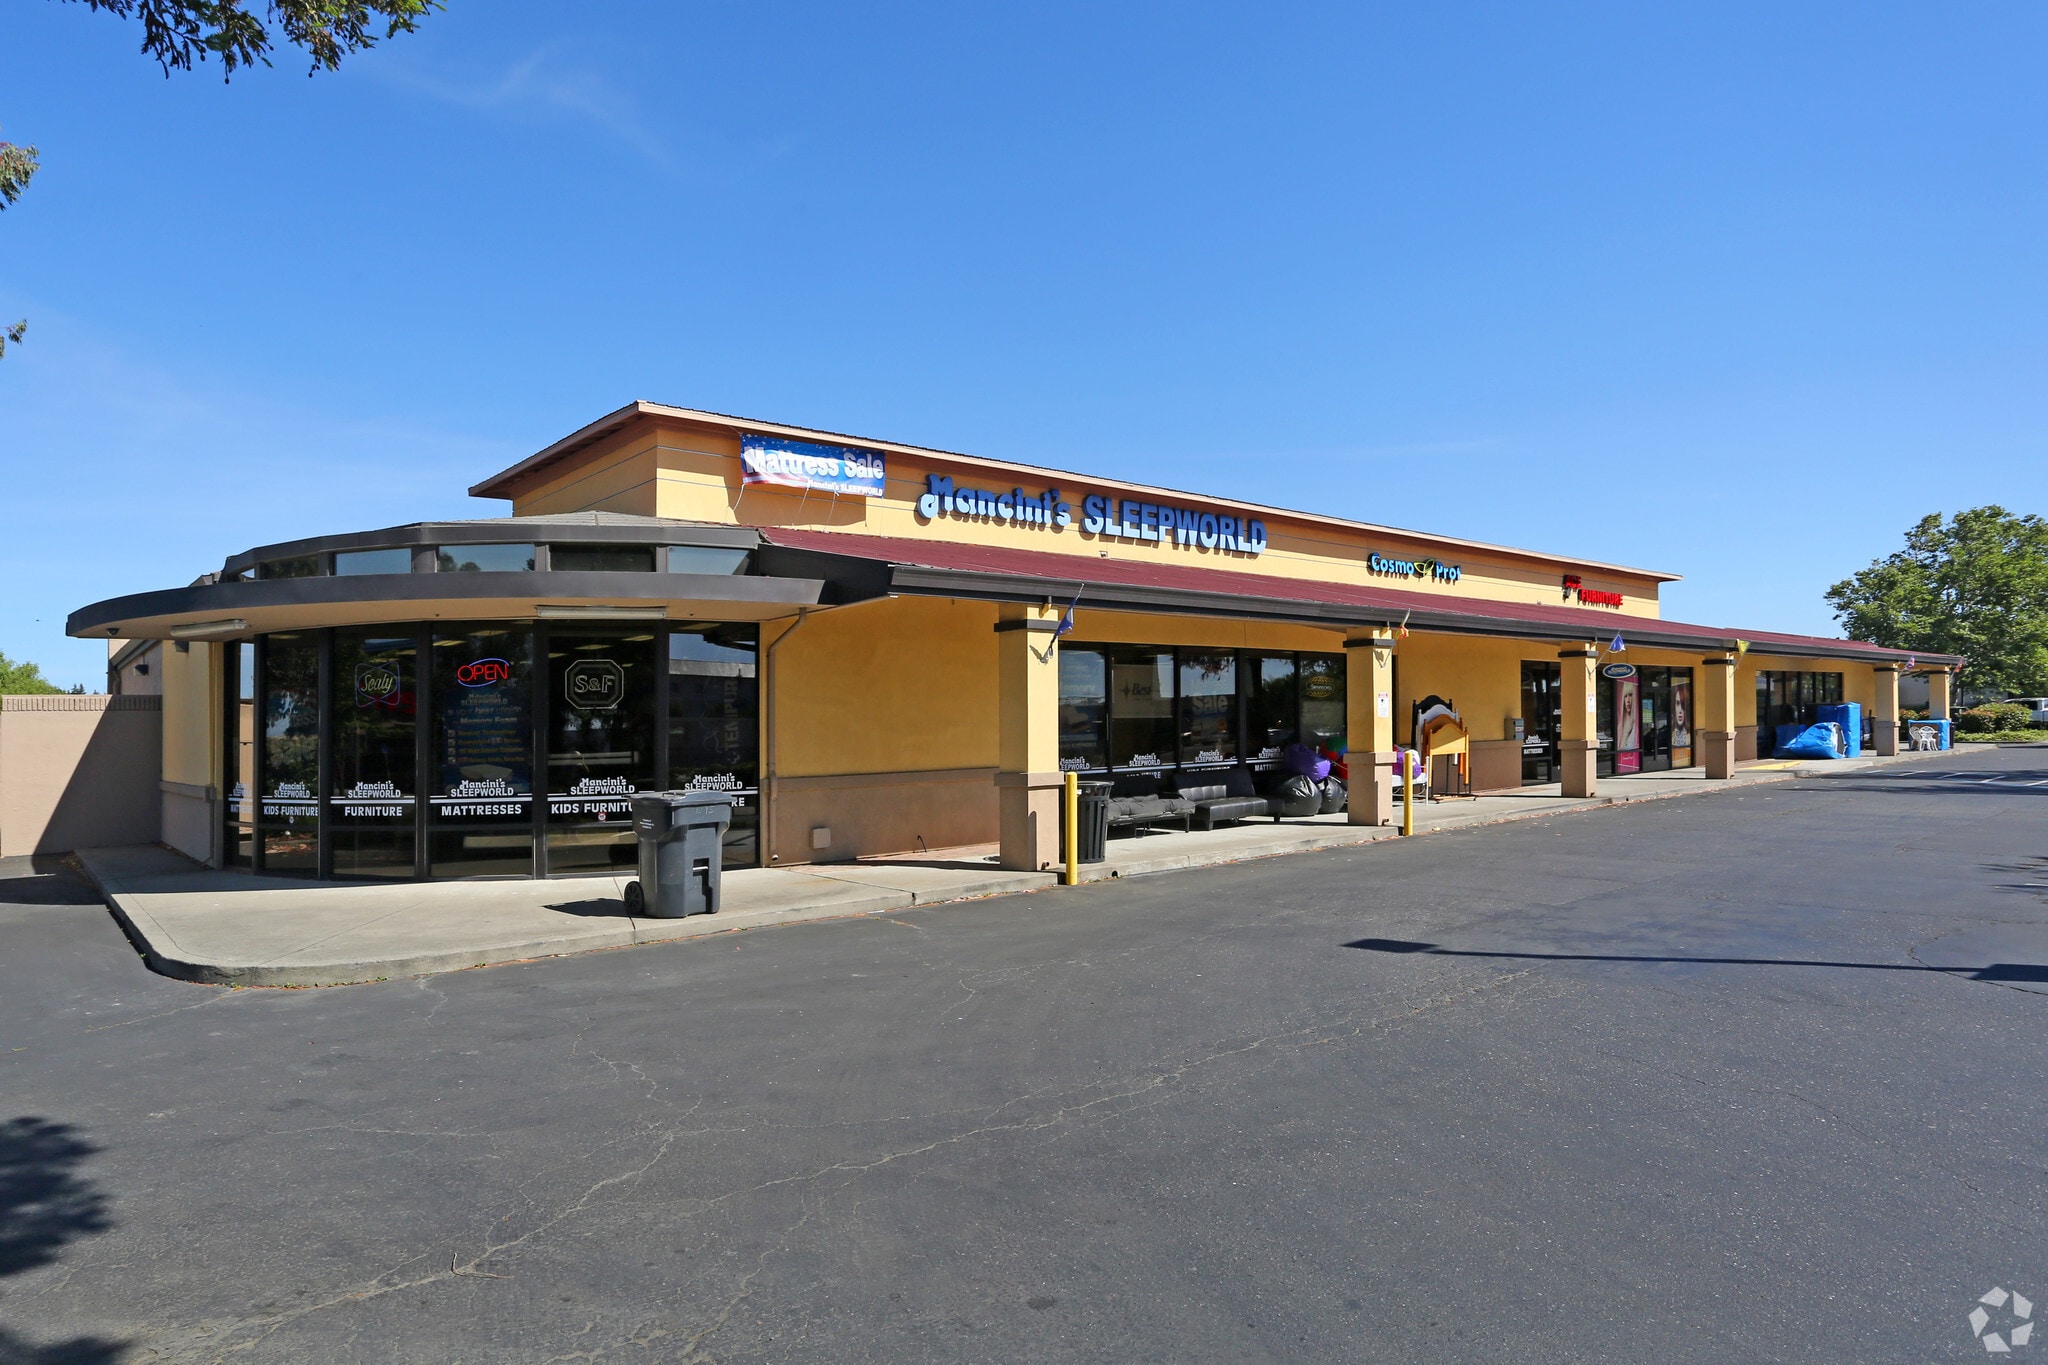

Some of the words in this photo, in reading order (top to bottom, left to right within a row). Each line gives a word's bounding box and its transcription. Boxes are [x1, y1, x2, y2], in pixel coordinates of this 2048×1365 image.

[743, 446, 840, 477] Mattress
[843, 451, 884, 480] Sale
[807, 479, 839, 491] Mancini's
[840, 482, 883, 497] SLEEPWORLD
[918, 473, 1072, 527] Mancini's
[1081, 494, 1267, 554] SLEEPWORLD
[1368, 552, 1415, 575] Cosmo
[1579, 588, 1624, 606] FURNITURE
[457, 664, 508, 682] OPEN
[360, 673, 393, 694] Sealy
[574, 674, 616, 693] S&F
[1191, 691, 1229, 712] Sale
[1133, 753, 1157, 764] Mancini's
[1195, 755, 1224, 763] SLEEPWORLD
[1199, 749, 1220, 759] Mancini's
[1129, 759, 1161, 767] SLEEPWORLD
[459, 778, 506, 790] Mancini's
[579, 776, 627, 788] Mancini's
[692, 772, 735, 784] Mancini's
[279, 781, 306, 791] Mancini's
[355, 780, 394, 791] Mancini's
[570, 785, 635, 795] SLEEPWORLD
[684, 781, 743, 791] SLEEPWORLD
[273, 789, 311, 799] SLEEPWORLD
[347, 789, 402, 799] SLEEPWORLD
[450, 787, 514, 798] SLEEPWORLD
[263, 805, 280, 815] KIDS
[281, 805, 319, 816] FURNITURE
[344, 806, 403, 816] FURNITURE
[441, 804, 522, 816] MATTRESSES
[551, 803, 580, 814] KIDS
[583, 802, 632, 813] FURNIT
